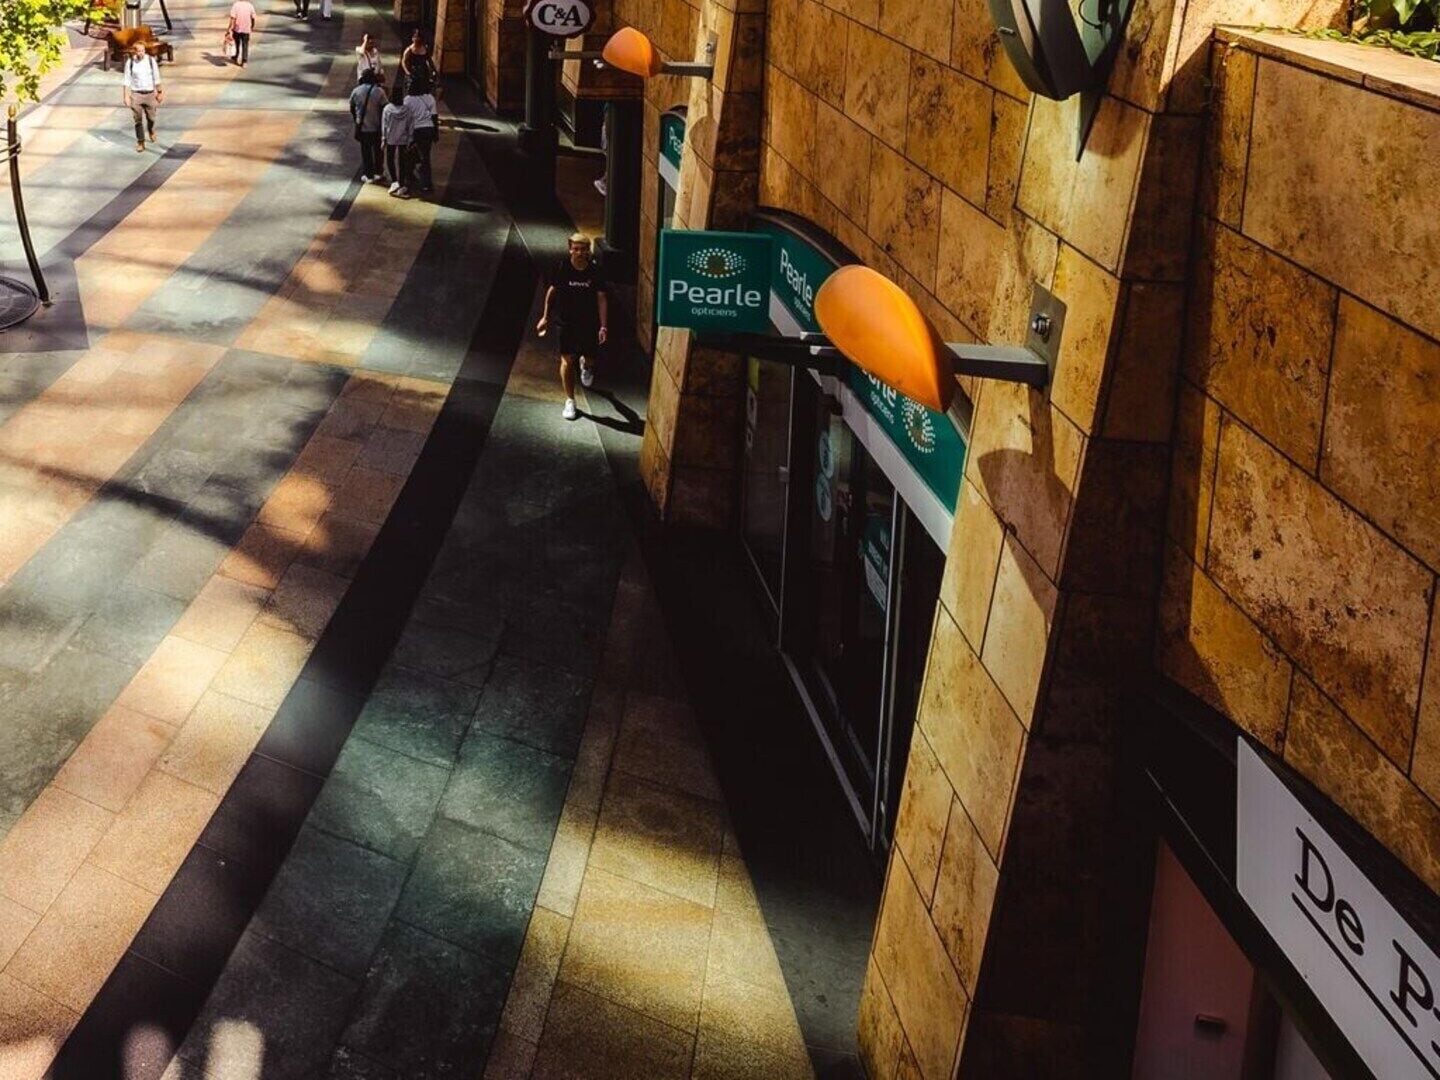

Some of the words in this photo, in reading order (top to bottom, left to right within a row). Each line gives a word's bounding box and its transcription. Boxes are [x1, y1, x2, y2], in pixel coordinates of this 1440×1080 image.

[537, 3, 583, 27] C&A
[780, 247, 813, 308] Pearle
[668, 279, 761, 308] Pearle
[691, 306, 738, 318] opticiens
[1294, 825, 1365, 957] De
[1389, 938, 1440, 1058] P
